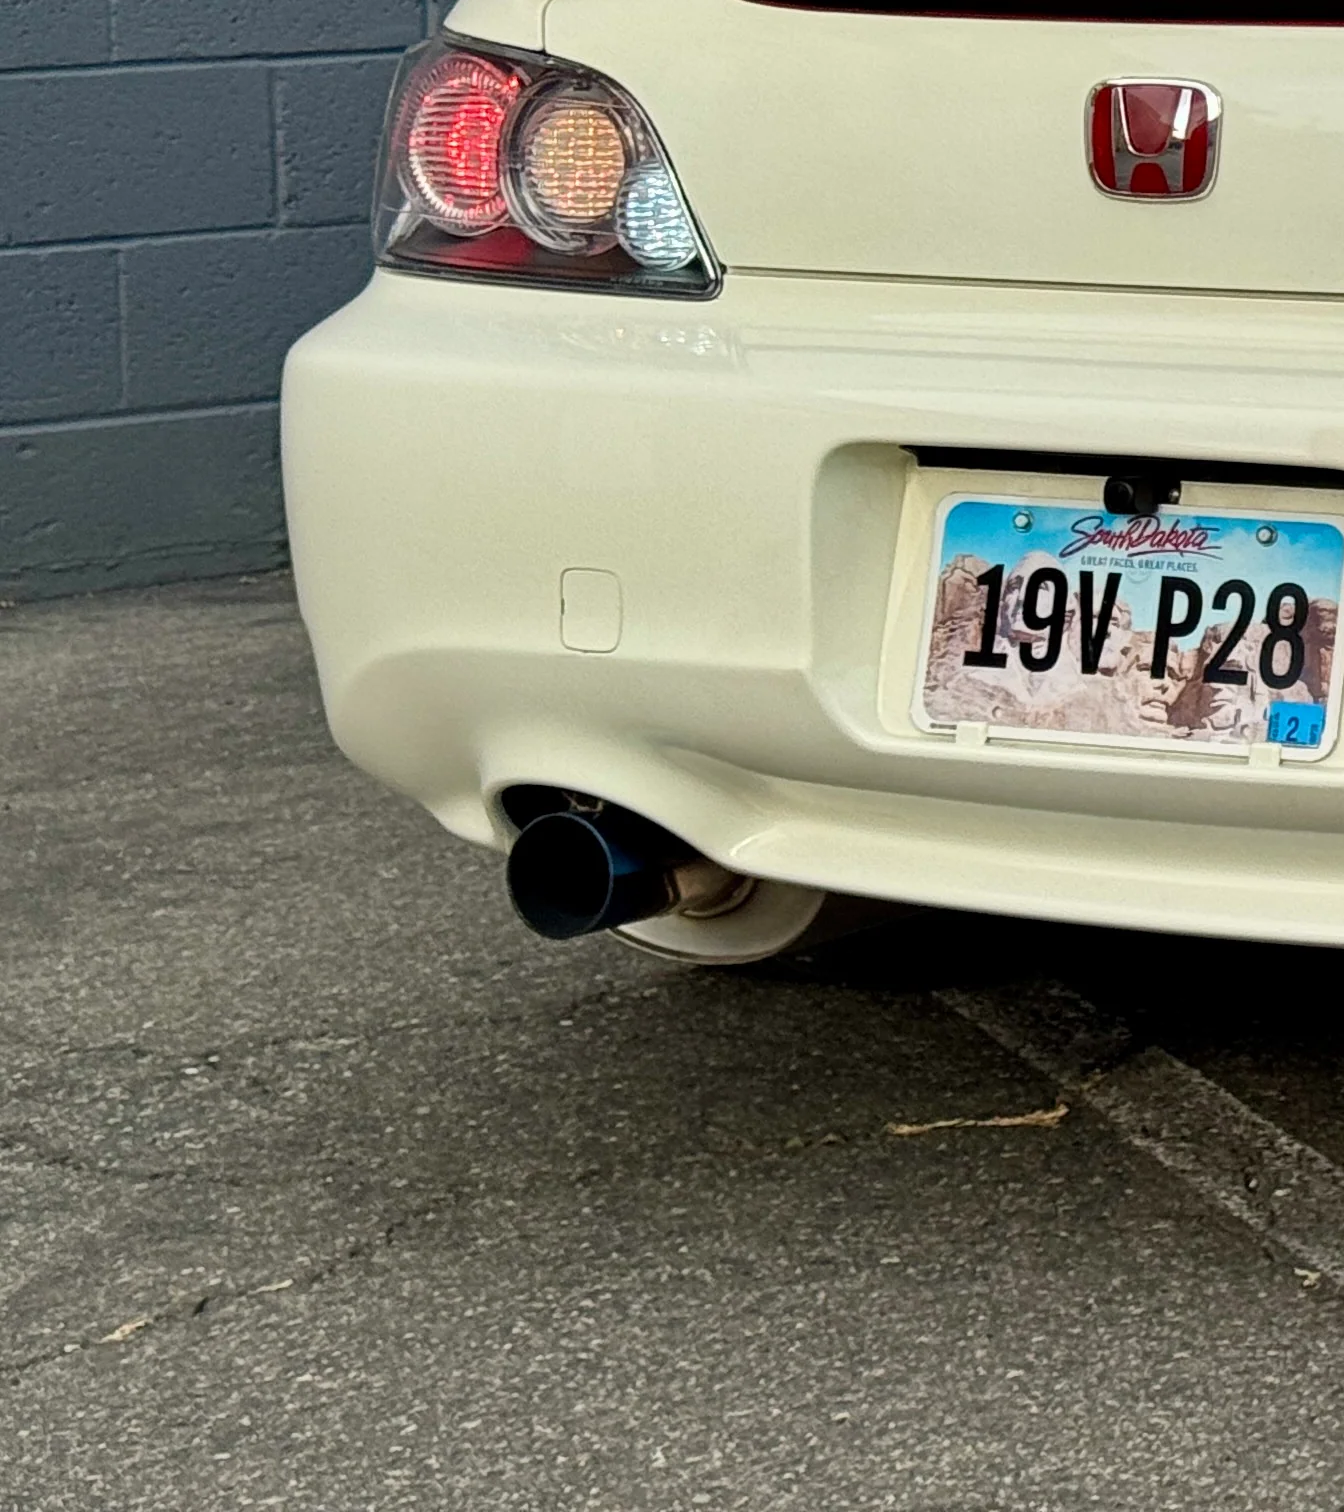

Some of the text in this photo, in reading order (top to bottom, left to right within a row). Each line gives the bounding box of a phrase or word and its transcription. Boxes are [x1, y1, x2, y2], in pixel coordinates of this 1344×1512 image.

[962, 563, 1309, 690] 19V P28
[1286, 716, 1299, 742] 2
